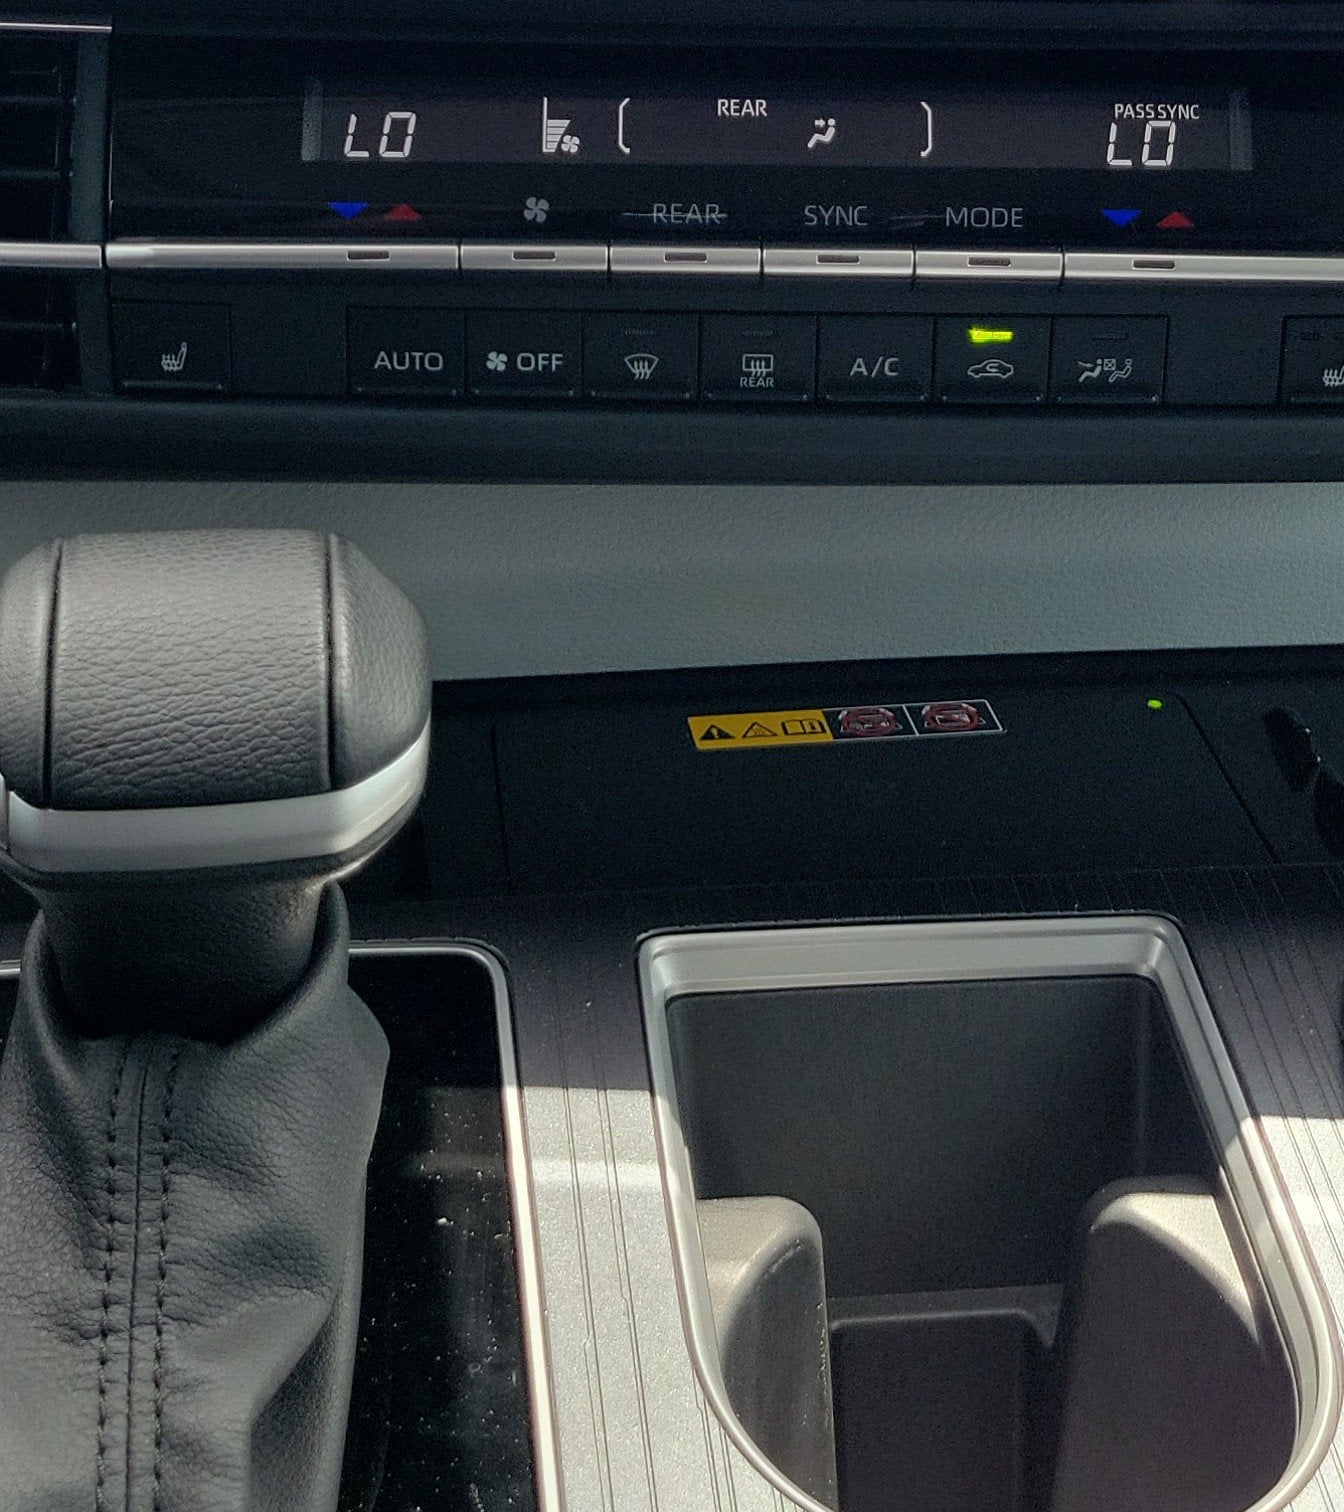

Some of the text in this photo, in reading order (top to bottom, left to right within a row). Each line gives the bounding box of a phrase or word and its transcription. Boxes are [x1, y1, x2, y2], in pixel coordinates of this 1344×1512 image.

[717, 99, 768, 117] REAR
[344, 112, 417, 158] LO
[1107, 121, 1176, 166] LO
[653, 203, 721, 224] REAR
[804, 205, 868, 227] SYNC
[945, 206, 1023, 228] MODE
[374, 351, 443, 371] AUTO
[516, 352, 563, 372] OFF
[850, 357, 899, 378] A/C
[740, 377, 774, 388] REAR
